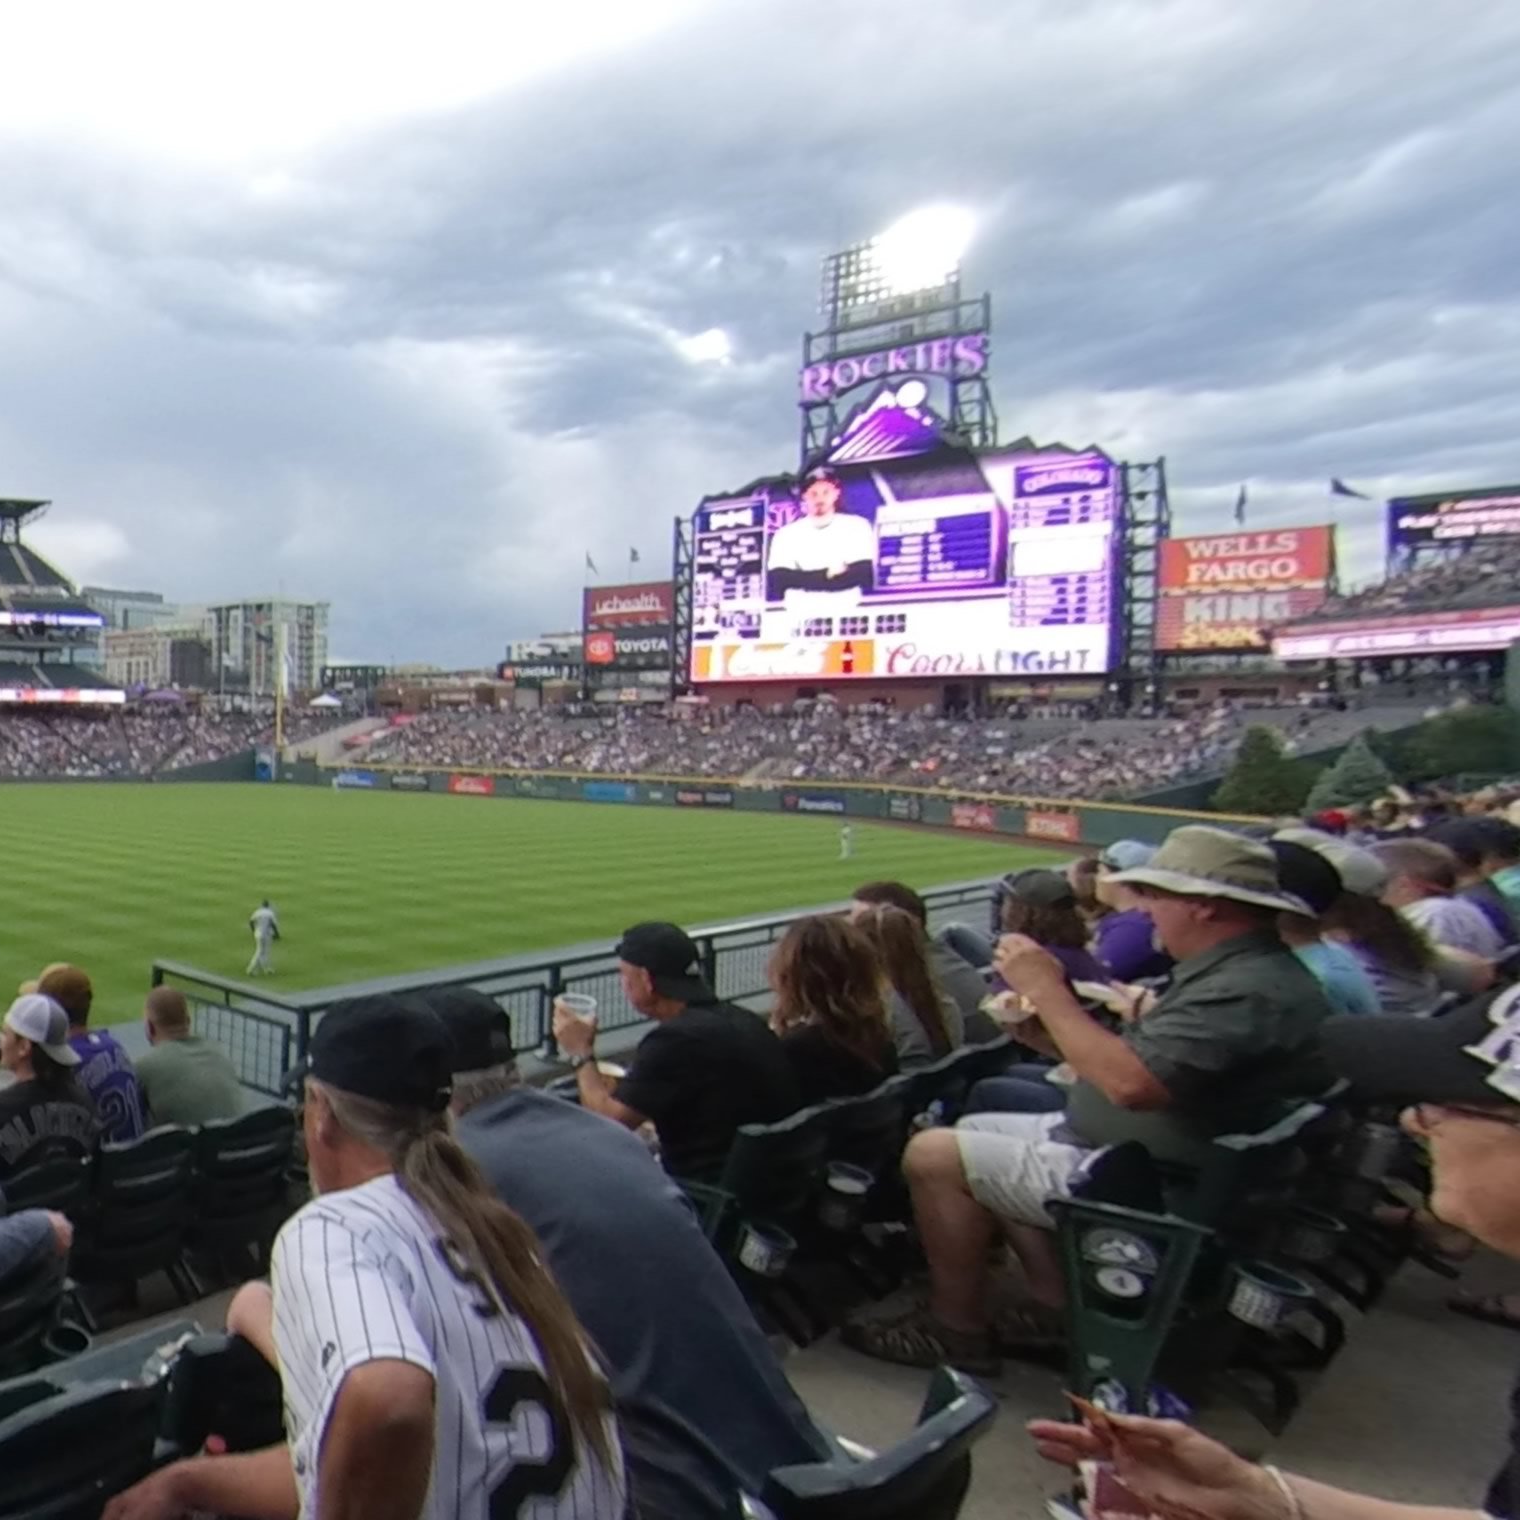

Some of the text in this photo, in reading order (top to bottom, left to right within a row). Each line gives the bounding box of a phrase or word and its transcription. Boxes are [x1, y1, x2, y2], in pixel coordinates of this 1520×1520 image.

[803, 334, 986, 401] ROCKIES
[1184, 533, 1298, 559] WELLS
[1186, 557, 1298, 583] FARGO
[1183, 592, 1291, 624] KING
[613, 637, 668, 654] TOYOTA
[886, 643, 1091, 674] Coors LIGHT
